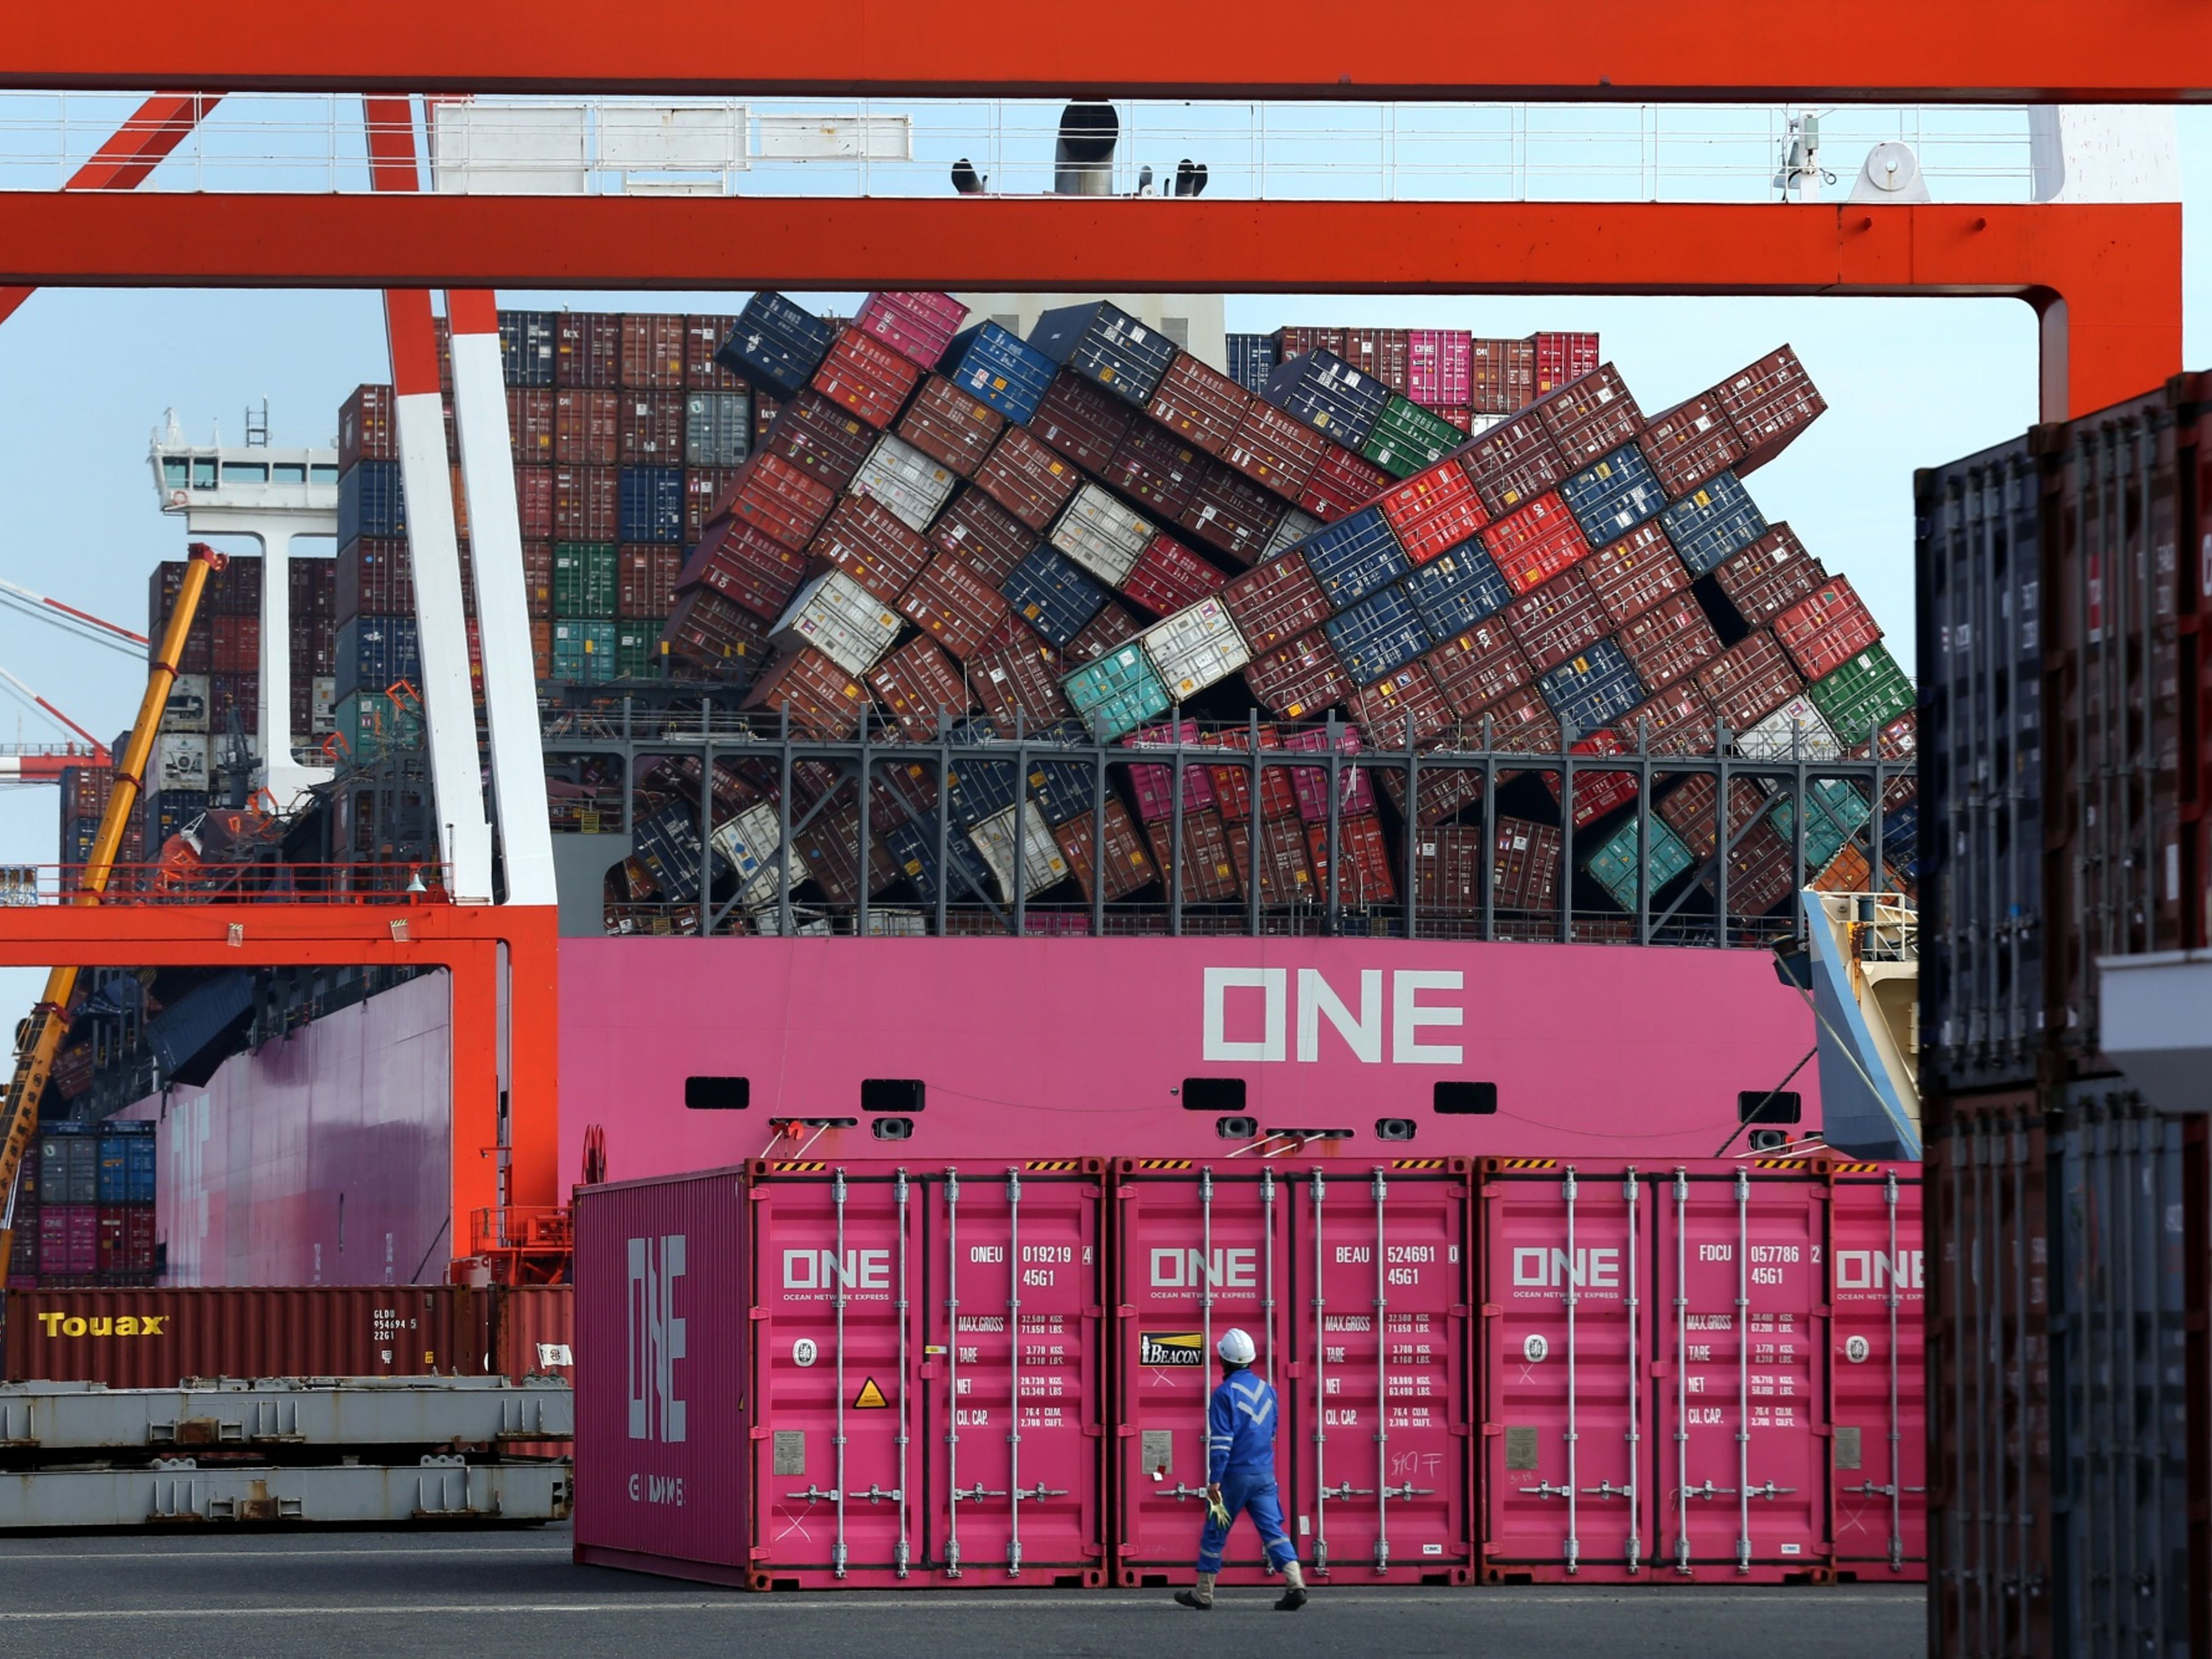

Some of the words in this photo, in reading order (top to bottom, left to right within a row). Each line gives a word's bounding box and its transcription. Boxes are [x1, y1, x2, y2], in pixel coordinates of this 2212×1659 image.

[876, 311, 894, 333] ONE
[1415, 345, 1434, 353] ONE
[1203, 967, 1464, 1064] ONE
[970, 1247, 1003, 1263] ONEU
[1023, 1247, 1071, 1263] 019219
[1083, 1247, 1092, 1263] 4
[1336, 1247, 1370, 1263] BEAU
[1388, 1246, 1434, 1263] 524691
[1699, 1245, 1732, 1261] FDCU
[1751, 1246, 1799, 1263] 057786
[1811, 1246, 1820, 1263] 2
[783, 1250, 890, 1288] ONE
[1151, 1248, 1256, 1286] ONE
[1513, 1247, 1619, 1287] ONE
[1023, 1270, 1054, 1286] 45G1
[1388, 1268, 1418, 1285] 45G1
[1751, 1268, 1783, 1284] 45G1
[39, 1312, 164, 1337] Touax
[959, 1316, 1004, 1332] MAX.GROSS
[1326, 1316, 1370, 1331] MAX.GROSS
[1686, 1315, 1732, 1330] MAX.GROSS
[374, 1331, 394, 1340] 22G1
[628, 1235, 686, 1443] ONE
[959, 1347, 977, 1362] TARE
[1150, 1344, 1201, 1364] BEACON
[1326, 1347, 1345, 1362] TARE
[1688, 1345, 1710, 1361] TARE
[957, 1378, 972, 1394] NET
[1326, 1378, 1341, 1393] NET
[1688, 1377, 1704, 1392] NET
[957, 1410, 970, 1425] CU.
[972, 1410, 988, 1425] CAP.
[1326, 1410, 1339, 1424] CU.
[1341, 1410, 1357, 1424] CAP.
[1688, 1408, 1703, 1423] CU.
[1704, 1408, 1724, 1423] CAP.
